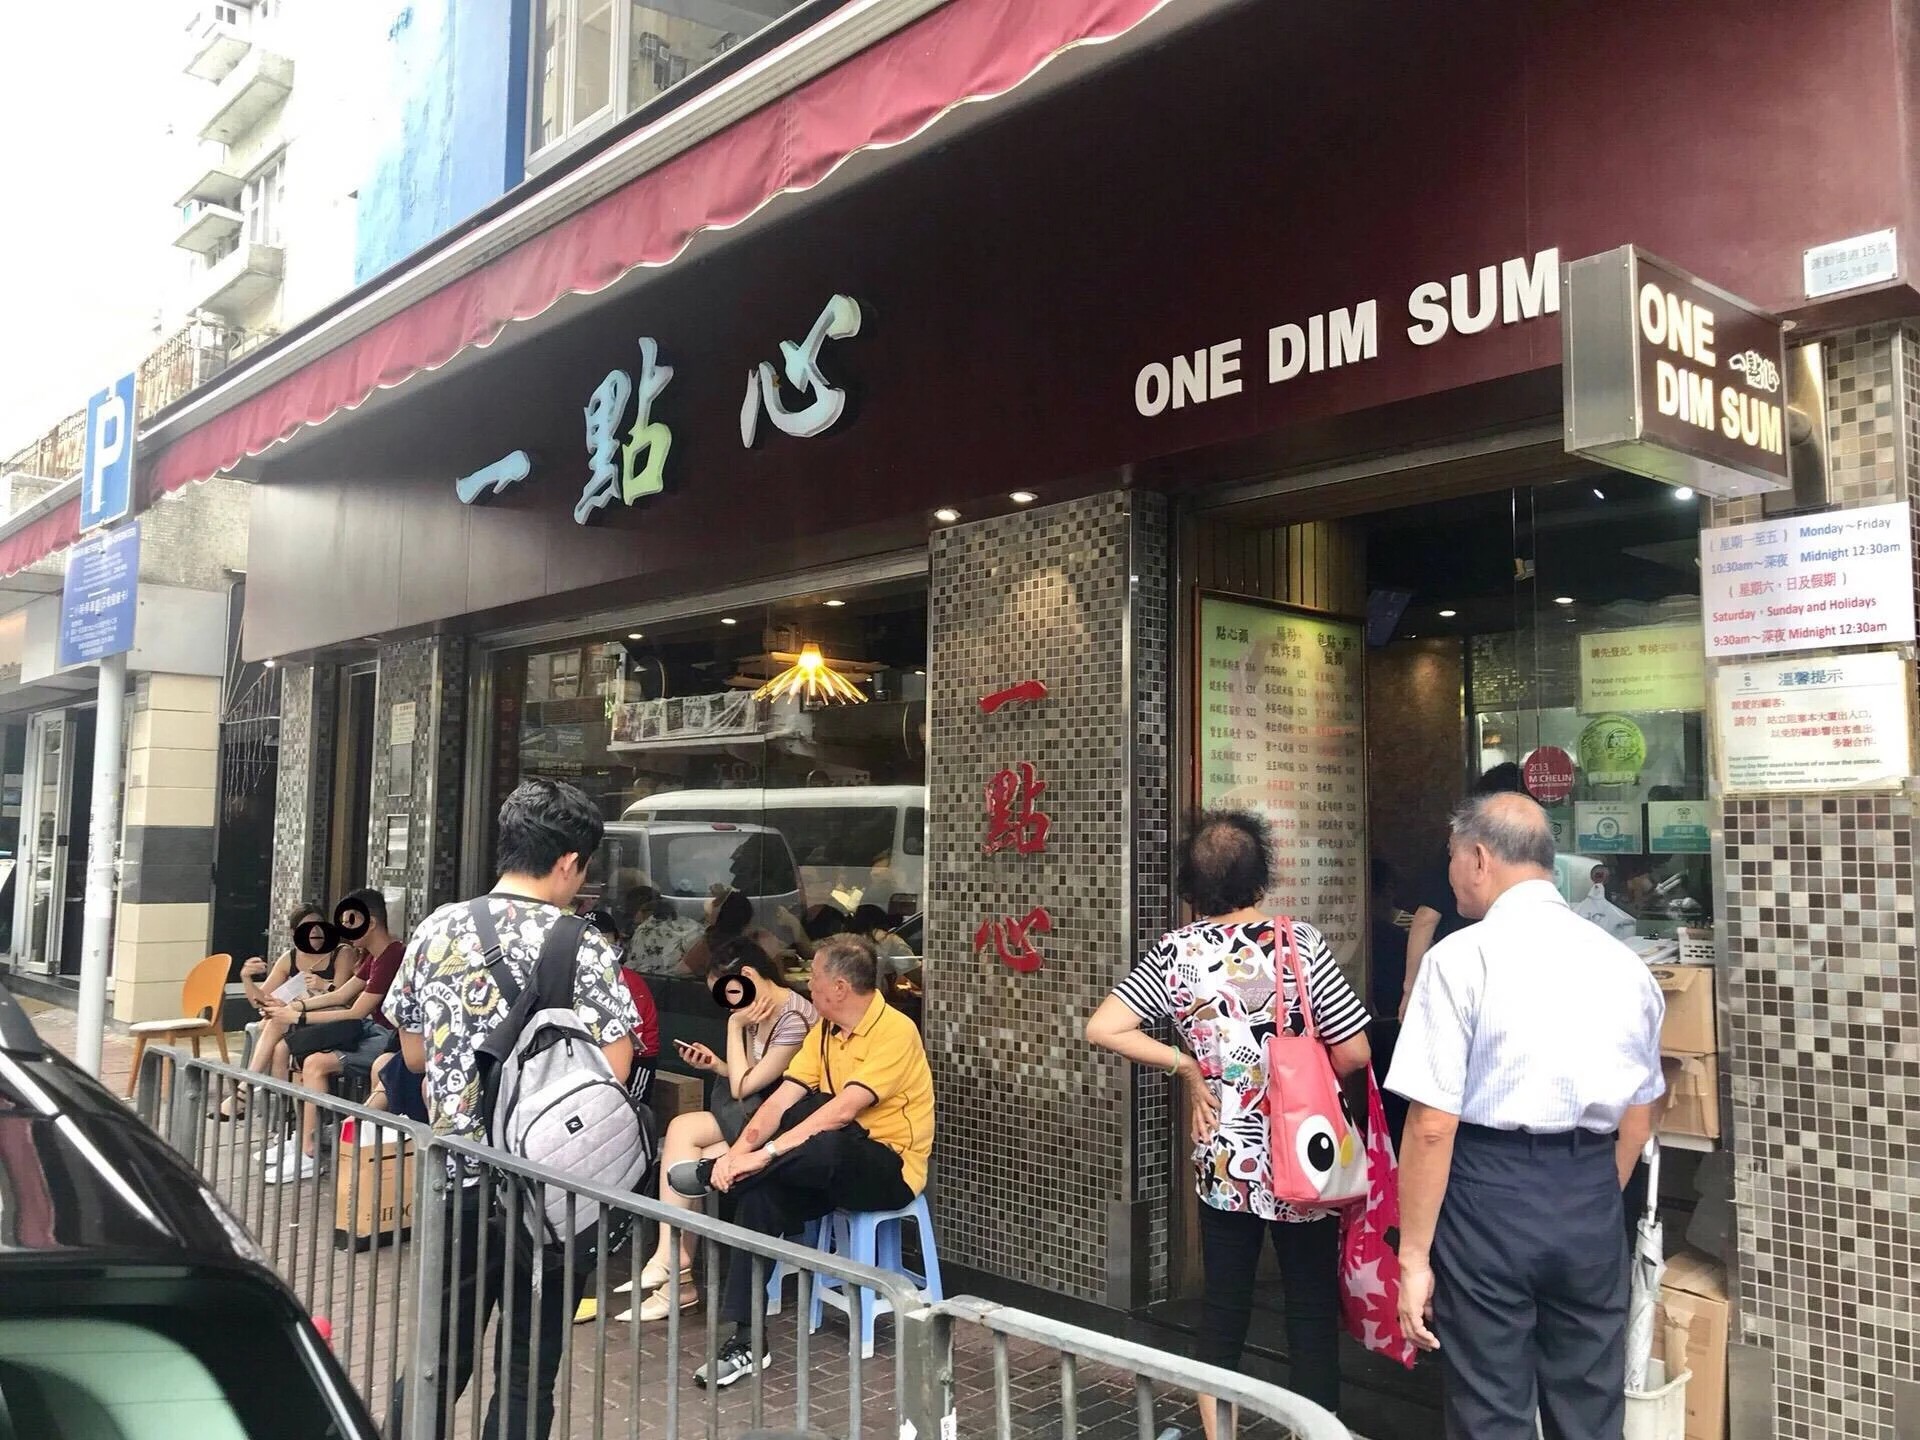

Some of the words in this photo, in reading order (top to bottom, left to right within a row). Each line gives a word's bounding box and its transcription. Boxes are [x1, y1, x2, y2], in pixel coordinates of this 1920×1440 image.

[1135, 338, 1242, 417] ONE
[1269, 299, 1377, 384] DIM
[1407, 247, 1560, 346] SUM
[1640, 283, 1716, 367] ONE
[456, 294, 862, 525] 一點心
[1656, 360, 1715, 431] DIM
[1721, 386, 1783, 455] SUM
[91, 395, 125, 514] P
[1800, 547, 1849, 562] Midnight
[1853, 543, 1901, 557] 12:30am
[1767, 603, 1804, 617] Sunday
[1806, 601, 1826, 613] and
[1829, 597, 1877, 610] Holidays
[1789, 625, 1836, 639] Midnight
[1840, 622, 1887, 635] 12:30am
[1778, 669, 1843, 686] 溫馨提示
[1528, 774, 1572, 784] MCHELIN
[974, 679, 1053, 974] 一點心
